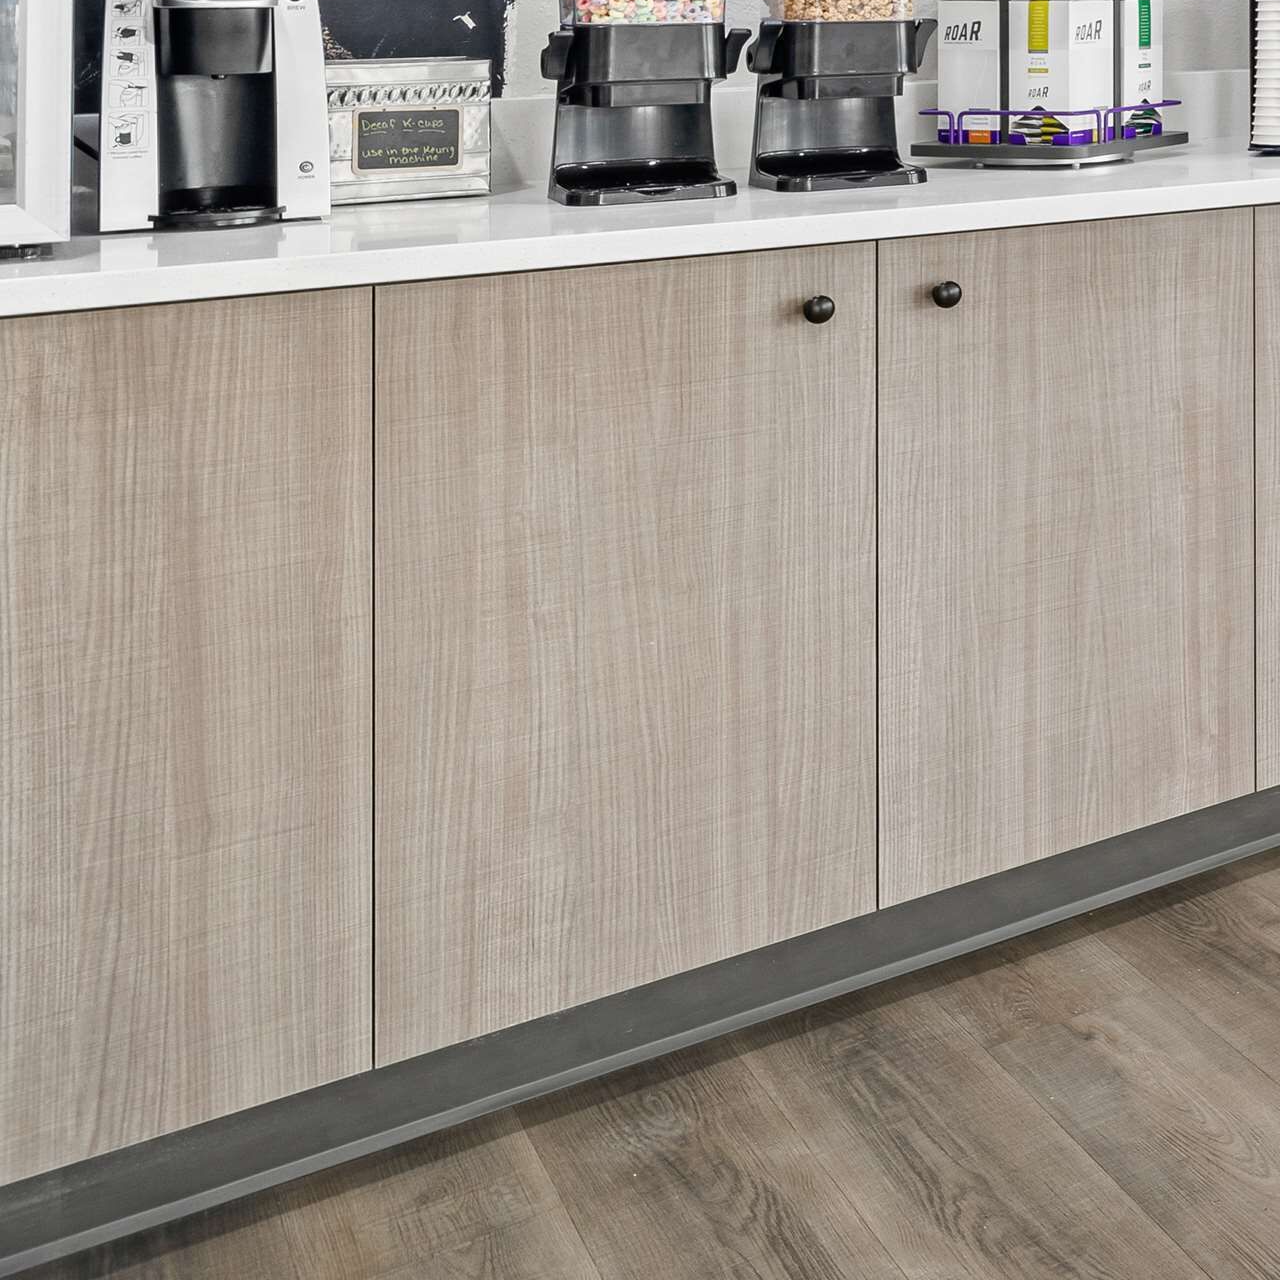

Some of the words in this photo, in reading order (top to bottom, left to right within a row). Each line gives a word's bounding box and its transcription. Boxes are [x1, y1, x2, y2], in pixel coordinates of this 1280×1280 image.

[944, 20, 982, 41] ROAR
[1074, 20, 1102, 41] ROAR
[1028, 86, 1049, 98] ROAR
[361, 118, 396, 131] Decaf
[361, 149, 384, 158] use
[386, 147, 397, 155] in
[389, 153, 438, 165] machine
